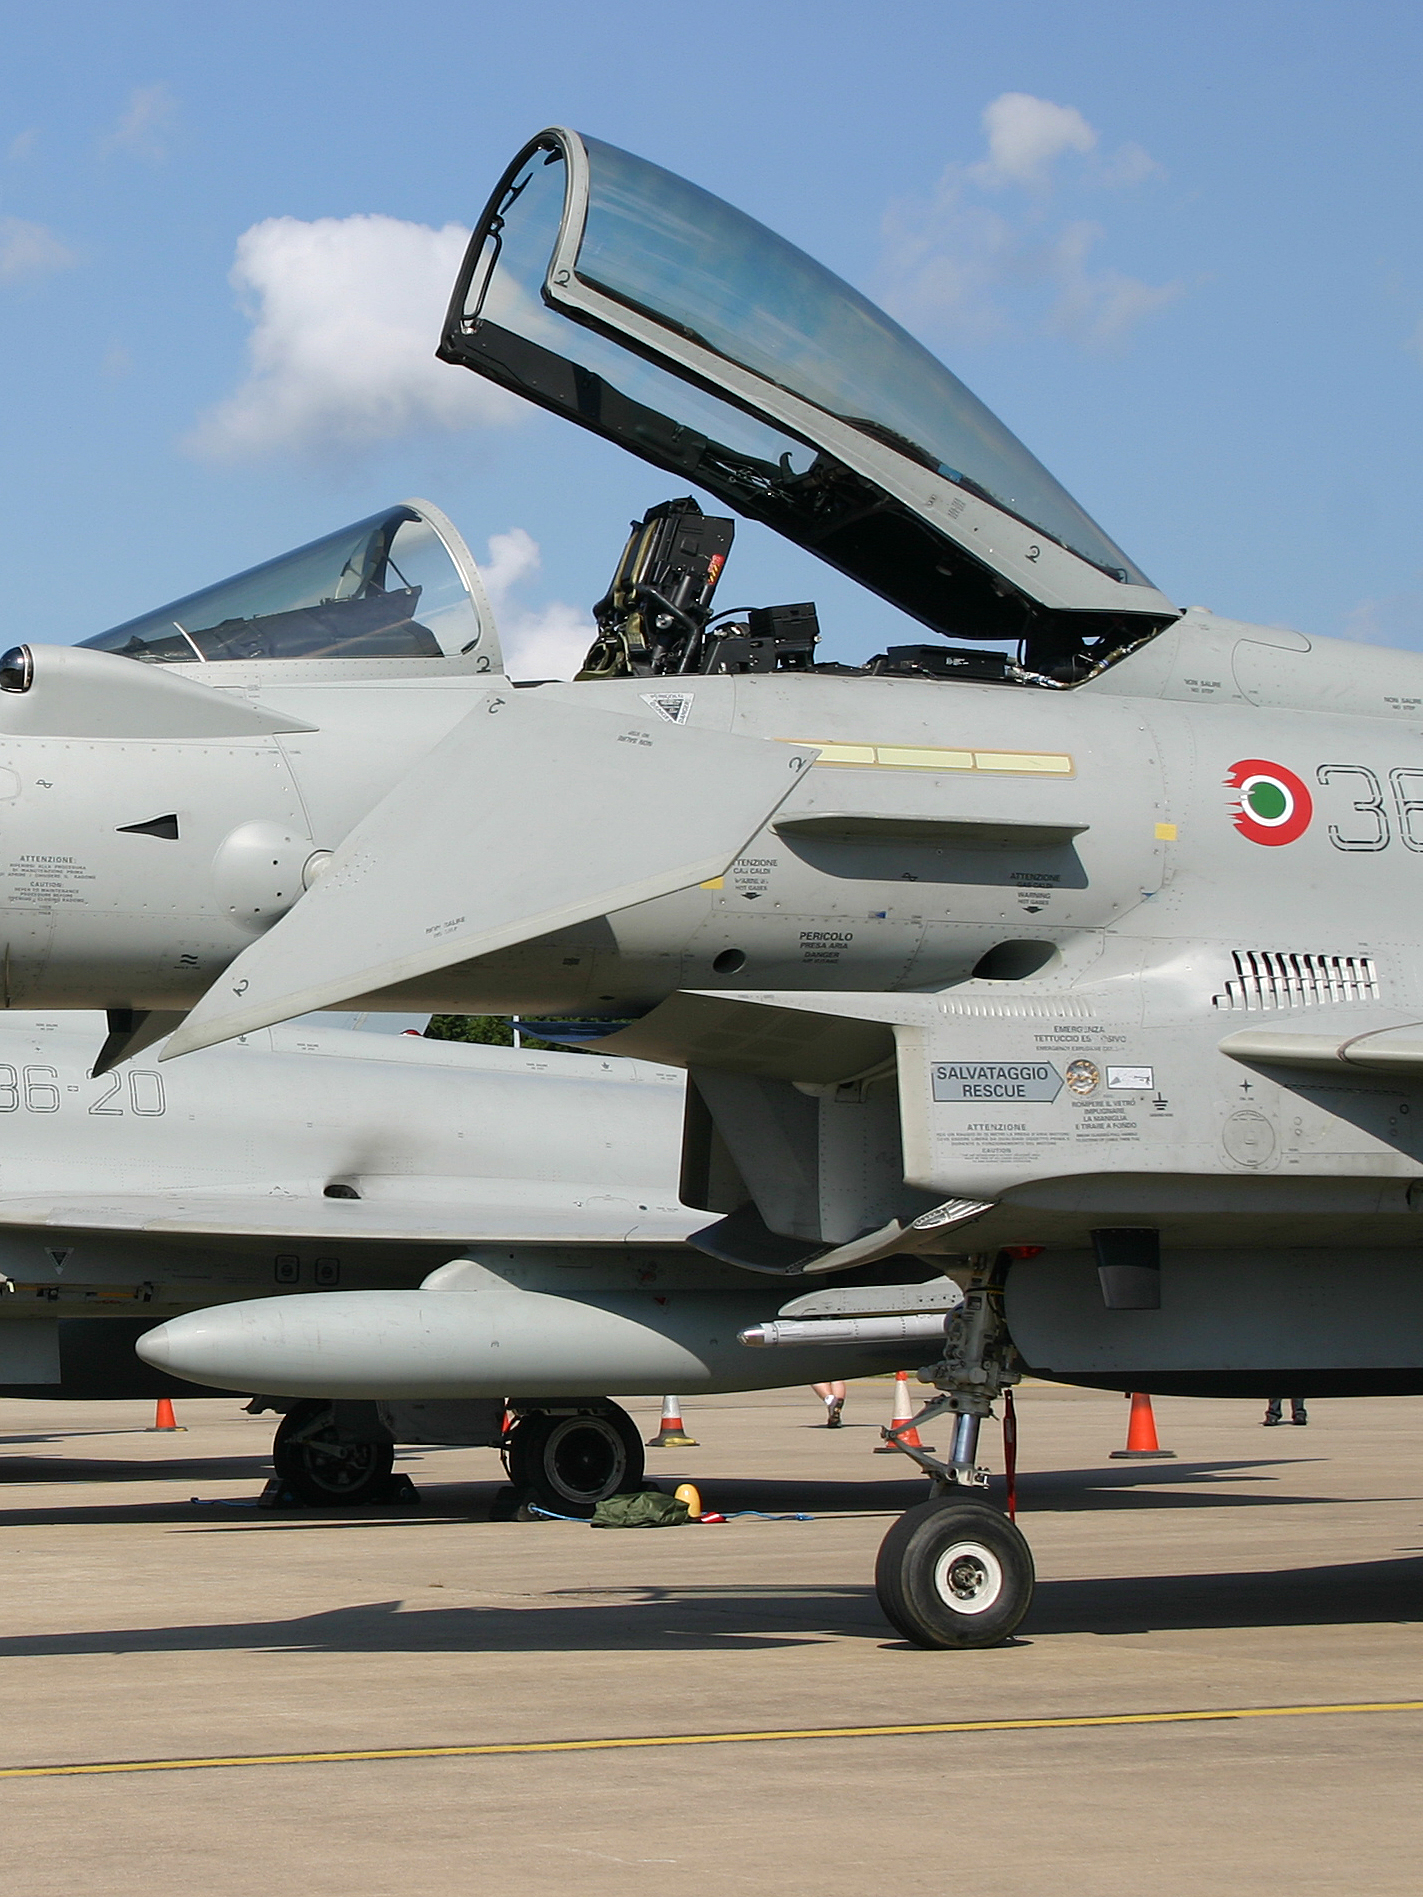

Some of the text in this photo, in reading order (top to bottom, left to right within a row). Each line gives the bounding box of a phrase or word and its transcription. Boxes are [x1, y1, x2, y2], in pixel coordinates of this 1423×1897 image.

[799, 931, 854, 941] PERICOLO
[1034, 1034, 1080, 1042] TETTUCCIO
[937, 1066, 1048, 1080] SALVATAGGIO
[962, 1084, 1026, 1098] RESCUE
[967, 1123, 1027, 1131] ATTENZIONE
